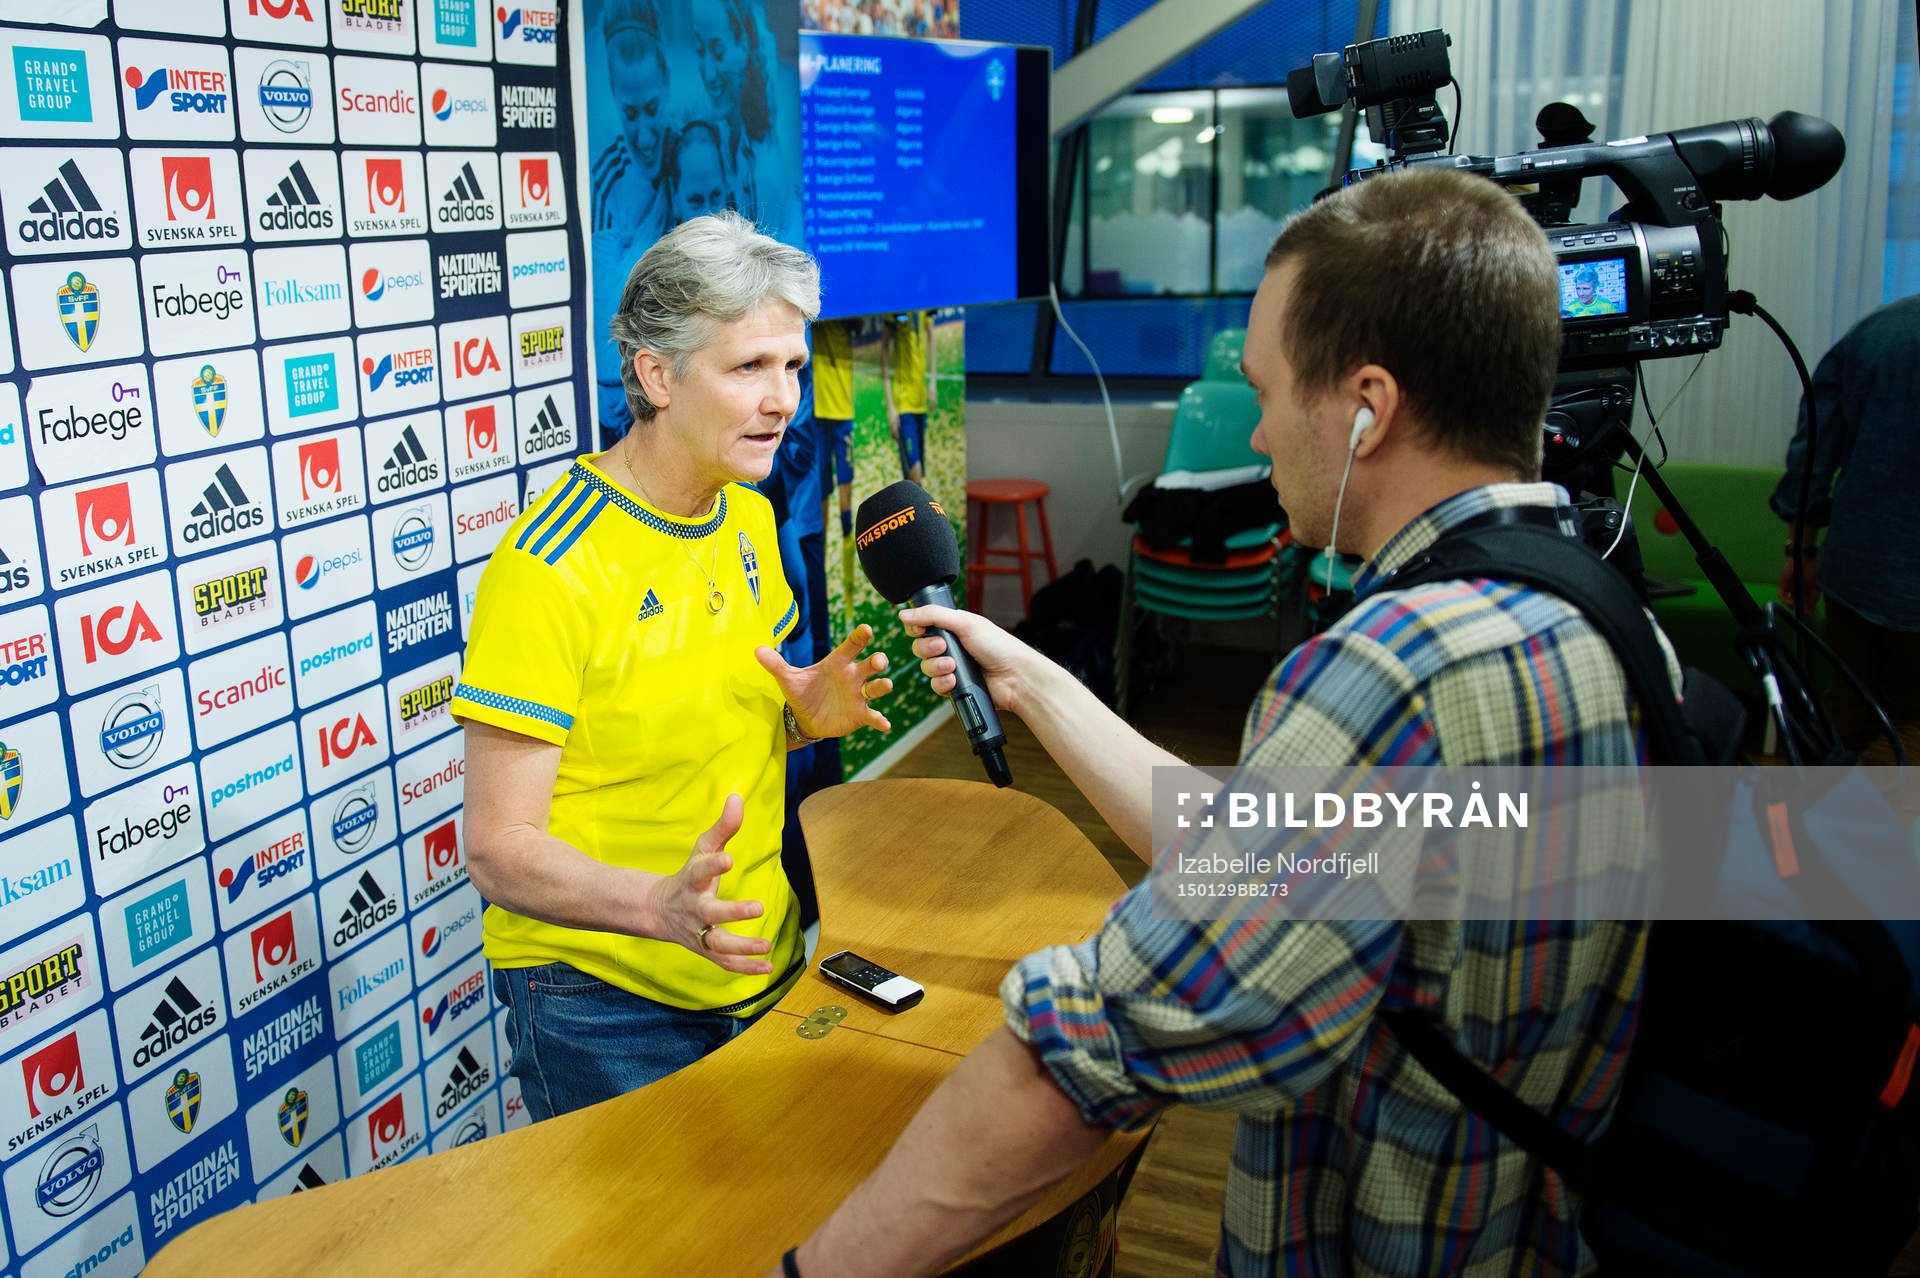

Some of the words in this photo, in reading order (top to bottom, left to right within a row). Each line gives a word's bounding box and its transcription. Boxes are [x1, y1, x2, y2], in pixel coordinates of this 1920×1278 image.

[346, 17, 401, 31] BLADET
[440, 11, 469, 25] TRAVEL
[440, 24, 466, 37] GROUP
[24, 60, 68, 75] GRAND
[169, 69, 225, 92] INTER
[27, 77, 78, 93] TRAVEL
[263, 90, 309, 103] VOLVO
[29, 94, 72, 110] GROUP
[170, 92, 227, 114] SPORT
[341, 87, 415, 114] Scandic
[454, 97, 486, 116] pepsi
[259, 205, 333, 230] adidas
[354, 220, 398, 231] SVENSKA
[400, 219, 421, 230] SPEL
[438, 200, 494, 223] adidas
[509, 213, 543, 223] SVENSKA
[545, 211, 561, 221] SPEL
[19, 211, 120, 243] adidas
[147, 227, 205, 241] SVENSKA
[209, 225, 237, 238] SPEL
[438, 251, 501, 276] NATIONAL
[512, 259, 565, 279] postnord
[264, 279, 341, 307] Folksam
[387, 272, 423, 289] pepsi
[440, 271, 502, 299] SPORTEN
[152, 283, 244, 320] Fabege
[520, 326, 565, 358] SPORT
[292, 363, 322, 379] GRAND
[393, 349, 433, 369] INTER
[454, 336, 502, 379] ICA
[293, 376, 329, 394] TRAVEL
[394, 366, 434, 388] SPORT
[294, 392, 325, 408] GROUP
[38, 405, 142, 444] Fabege
[525, 428, 571, 454] adidas
[377, 461, 438, 493] adidas
[455, 460, 491, 477] SVENSKA
[493, 455, 511, 467] SPEL
[286, 503, 332, 522] SVENSKA
[336, 495, 359, 509] SPEL
[456, 500, 516, 535] Scandic
[183, 507, 264, 543] adidas
[395, 531, 432, 548] VOLVO
[60, 556, 123, 583] SVENSKA
[128, 546, 159, 564] SPEL
[322, 549, 361, 576] pepsi
[194, 566, 268, 617] SPORT
[201, 599, 267, 627] BLADET
[386, 590, 452, 632] NATIONAL
[638, 604, 664, 621] adidas
[80, 600, 163, 664] ICA
[388, 610, 453, 654] SPORTEN
[0, 634, 45, 664] TER
[300, 632, 374, 676] postnord
[198, 665, 286, 716] Scandic
[400, 675, 453, 721] SPORT
[105, 717, 160, 745] VOLVO
[318, 712, 377, 768] ICA
[211, 754, 294, 808] postnord
[97, 804, 192, 861] Fabege
[336, 807, 375, 834] VOLVO
[255, 832, 303, 870] INTER
[257, 849, 305, 888] SPORT
[414, 878, 452, 904] SVENSKA
[135, 902, 172, 924] GRAND
[137, 911, 180, 938] TRAVEL
[333, 898, 397, 947] adidas
[443, 909, 475, 941] pepsi
[139, 925, 175, 952] GROUP
[239, 975, 288, 1011] SVENSKA
[290, 959, 315, 980] SPEL
[337, 957, 405, 1013] Folksam
[448, 970, 484, 1005] INTER
[0, 977, 82, 1028] BLADET
[450, 985, 485, 1021] SPORT
[133, 1007, 217, 1068] adidas
[243, 995, 322, 1060] NATIONAL
[245, 1013, 324, 1082] SPORTEN
[364, 1044, 395, 1072] TRAVEL
[436, 1068, 490, 1119] adidas
[8, 1105, 73, 1151] SVENSKA
[76, 1083, 109, 1110] SPEL
[400, 1132, 420, 1153] SPEL
[41, 1156, 98, 1198] VOLVO
[150, 1138, 239, 1215] NATIONAL
[153, 1156, 241, 1239] SPORTEN
